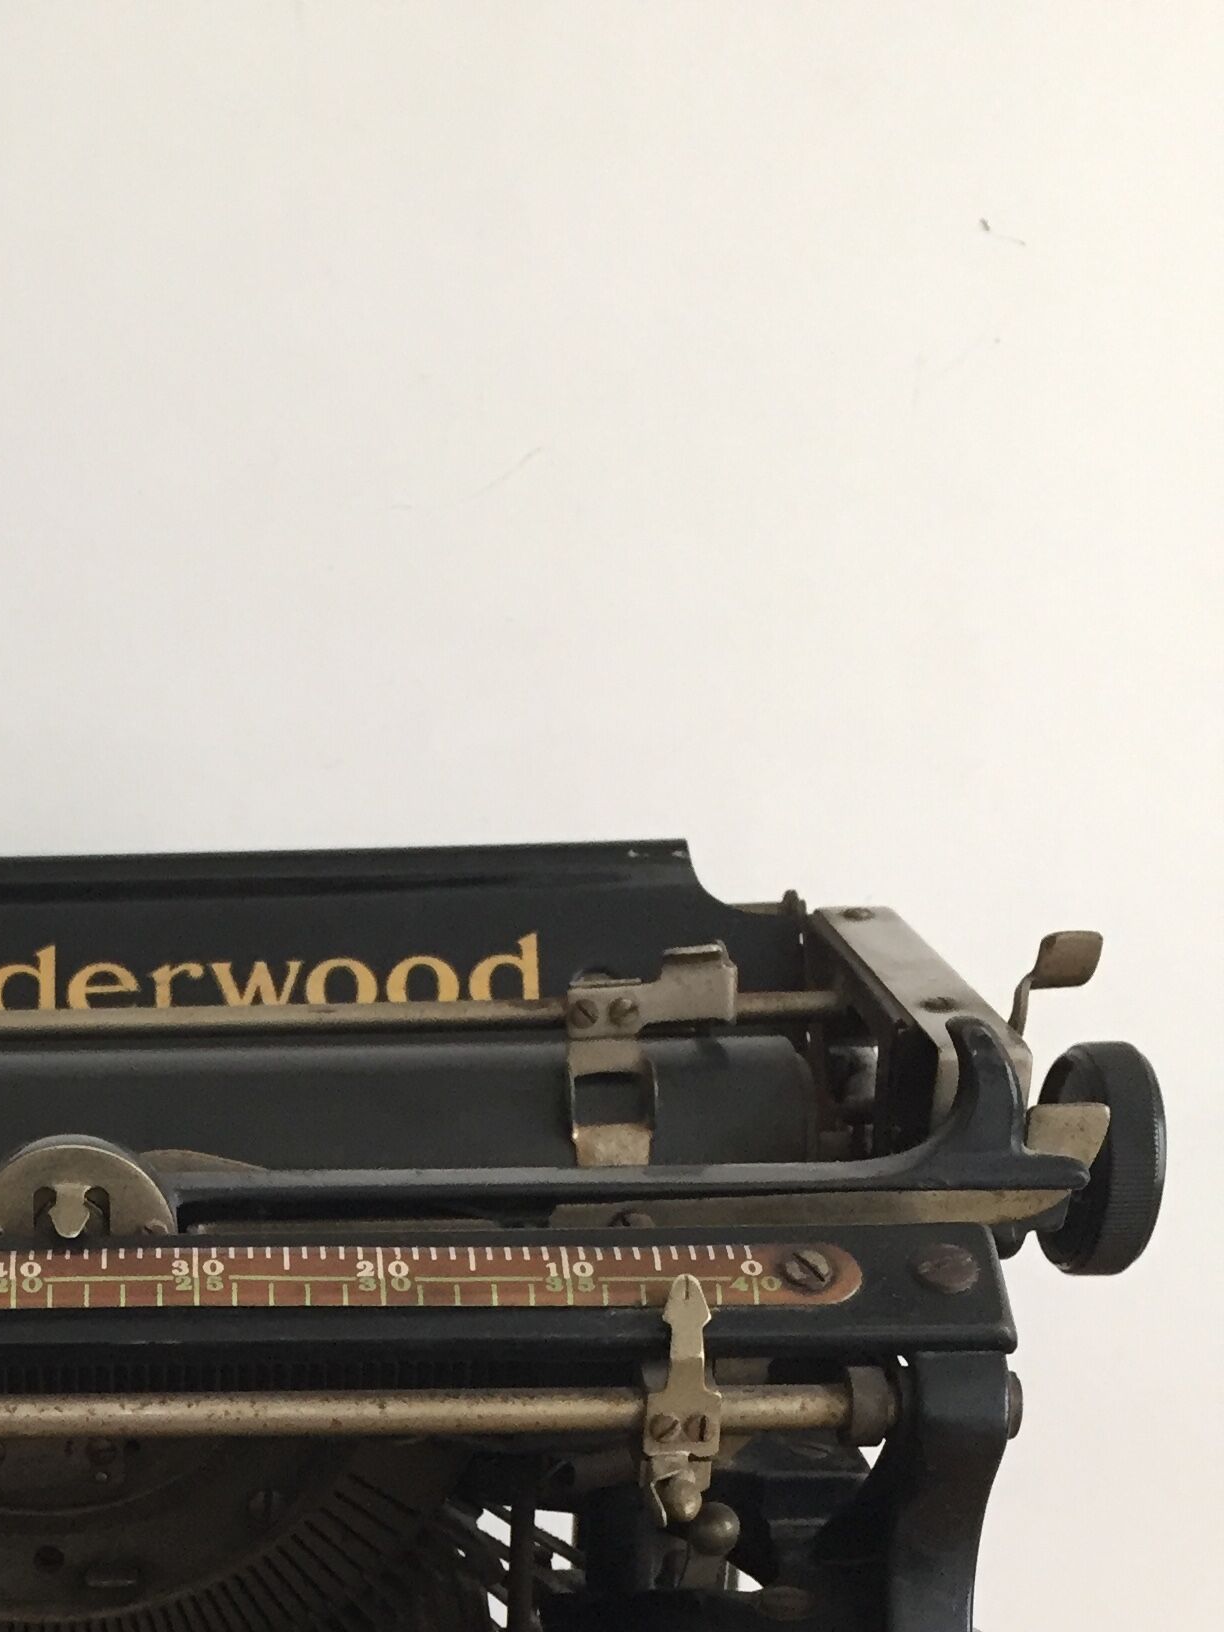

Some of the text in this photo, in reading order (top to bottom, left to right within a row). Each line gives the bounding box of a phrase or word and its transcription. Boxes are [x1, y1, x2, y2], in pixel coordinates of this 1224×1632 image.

[172, 1259, 225, 1276] 30
[356, 1260, 409, 1278] 20
[545, 1260, 594, 1278] 10
[740, 1259, 764, 1276] 0
[175, 1275, 224, 1292] 25
